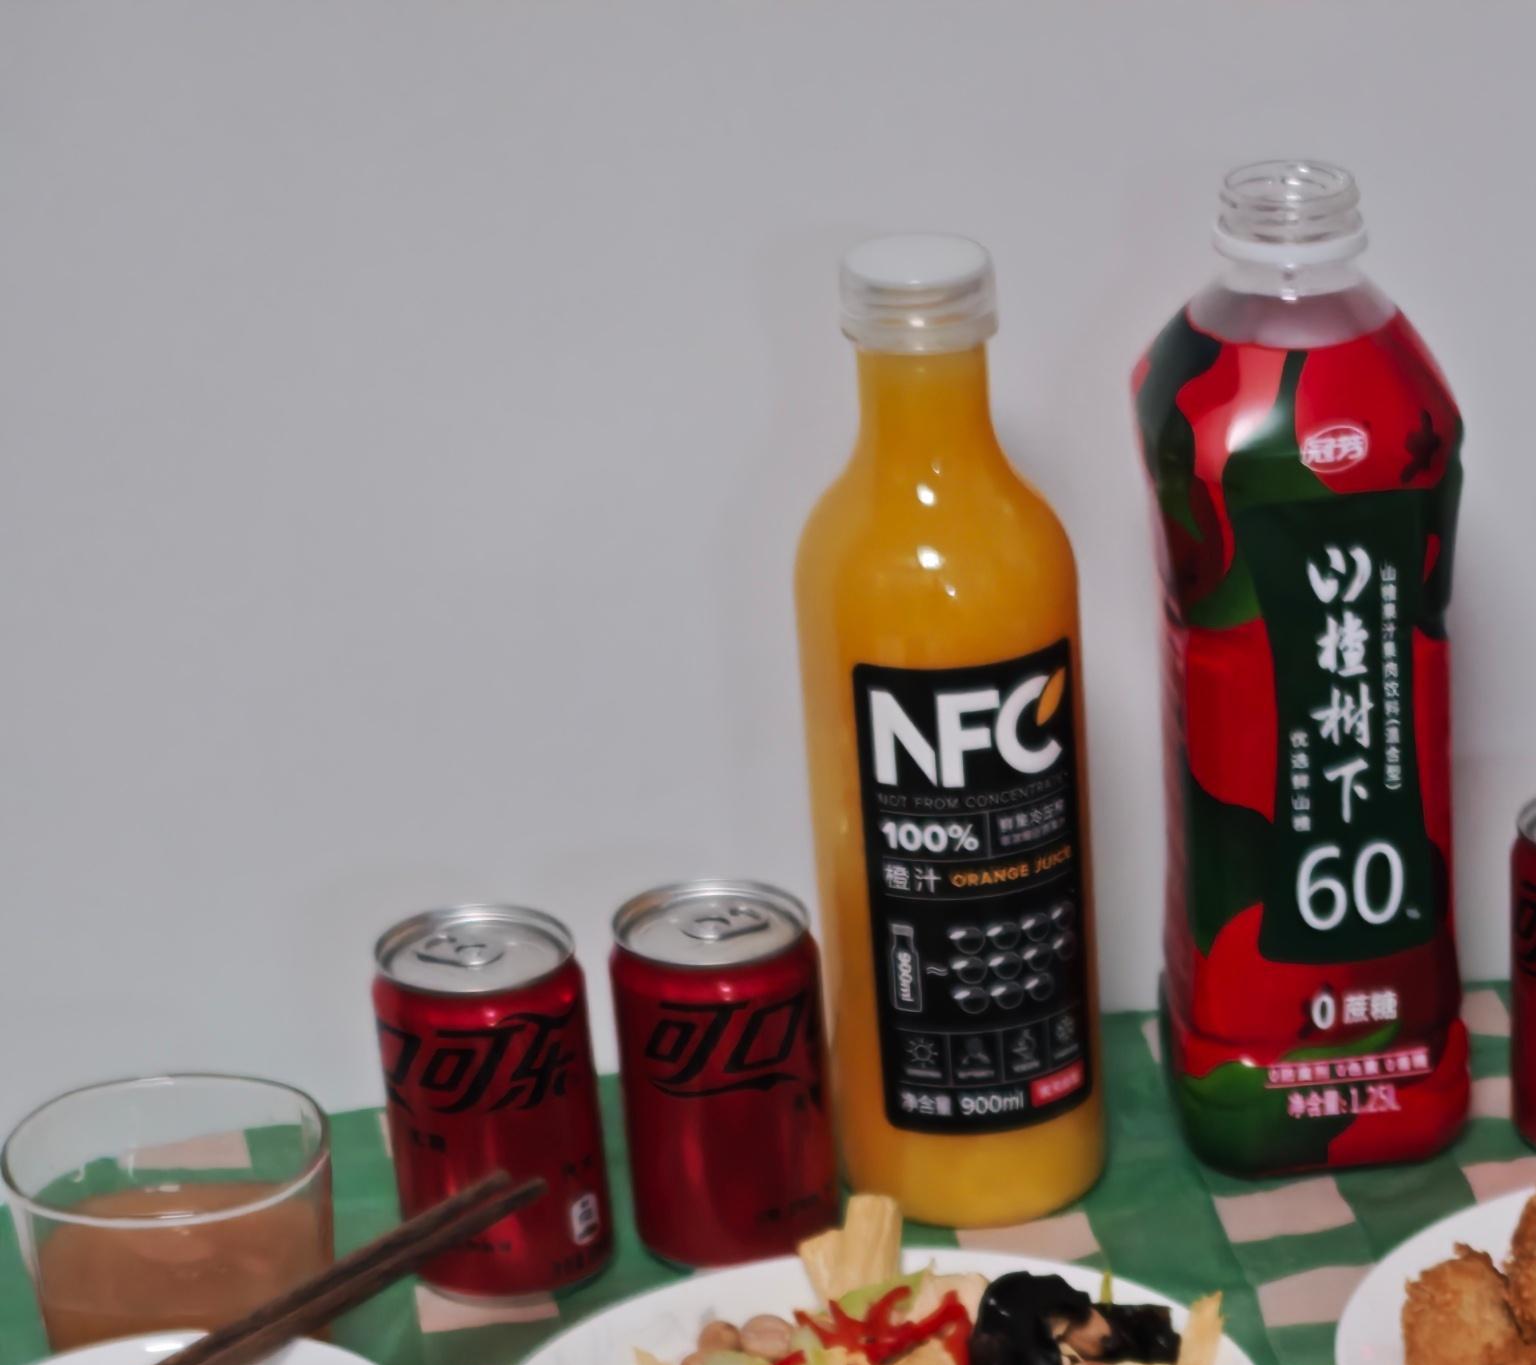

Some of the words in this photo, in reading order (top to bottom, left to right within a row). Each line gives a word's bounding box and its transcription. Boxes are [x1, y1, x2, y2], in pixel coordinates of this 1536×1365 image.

[1308, 547, 1374, 823] 山楂树下
[870, 675, 1062, 788] NFC
[913, 797, 959, 809] FROM
[881, 821, 979, 853] 100%
[884, 864, 943, 893] 橙汁
[951, 863, 1031, 888] ORANGE
[1296, 840, 1405, 931] 60
[960, 1089, 1024, 1116] 900ml
